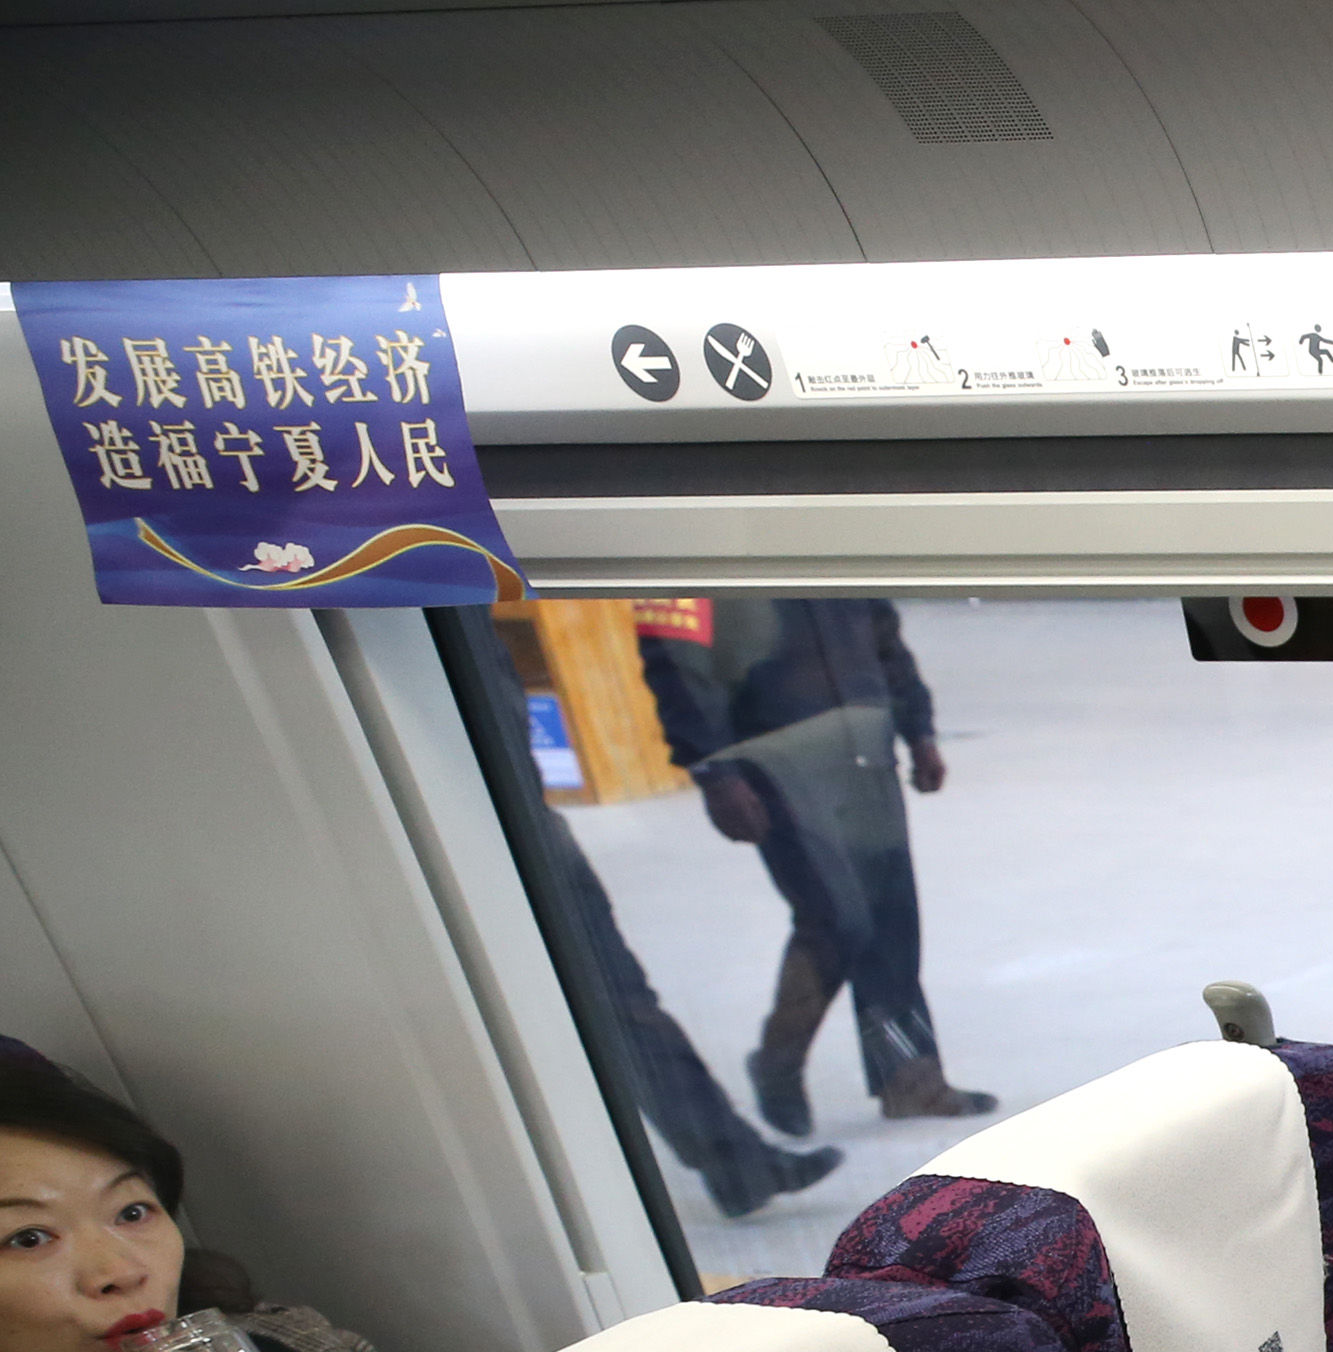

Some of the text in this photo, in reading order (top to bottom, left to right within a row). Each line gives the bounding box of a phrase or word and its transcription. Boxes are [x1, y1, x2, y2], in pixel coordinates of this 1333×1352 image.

[59, 329, 433, 410] 发展高铁经济
[957, 368, 973, 389] 2
[1115, 365, 1129, 386] 3
[794, 371, 807, 393] 1
[88, 418, 456, 492] 造福宁夏人民
